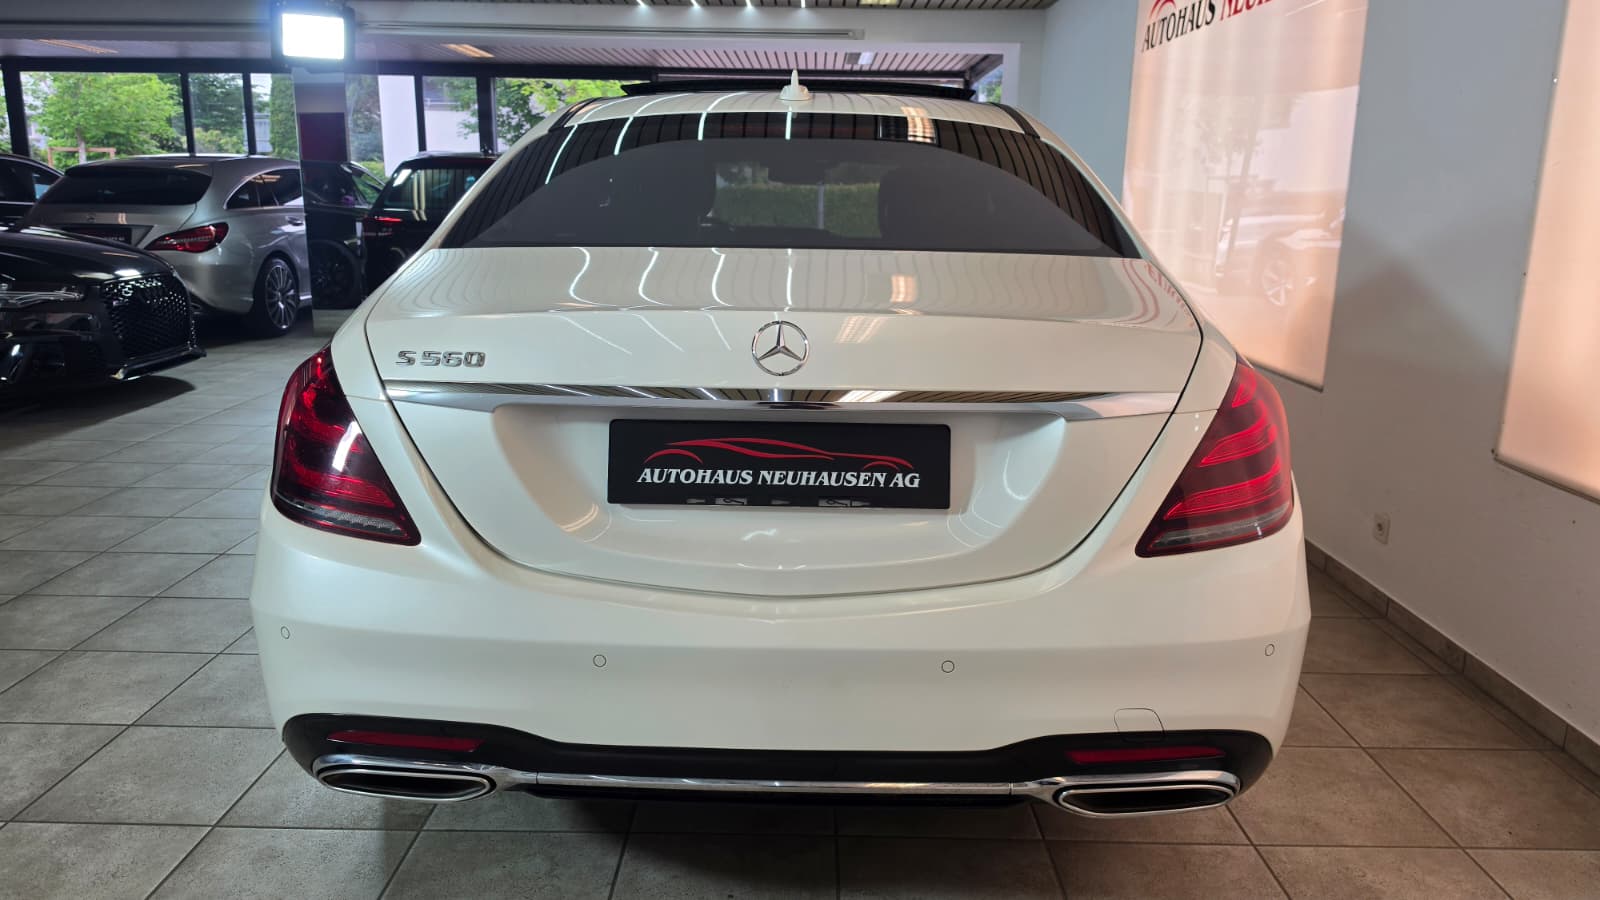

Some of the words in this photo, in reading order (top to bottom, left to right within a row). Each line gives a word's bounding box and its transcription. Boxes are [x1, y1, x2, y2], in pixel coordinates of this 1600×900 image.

[1141, 0, 1216, 52] AUTOHAUS
[395, 350, 416, 366] S
[420, 350, 486, 368] 560
[636, 468, 753, 485] AUTOHAUS
[757, 470, 887, 488] NEUHAUSEN
[889, 473, 921, 488] AG
